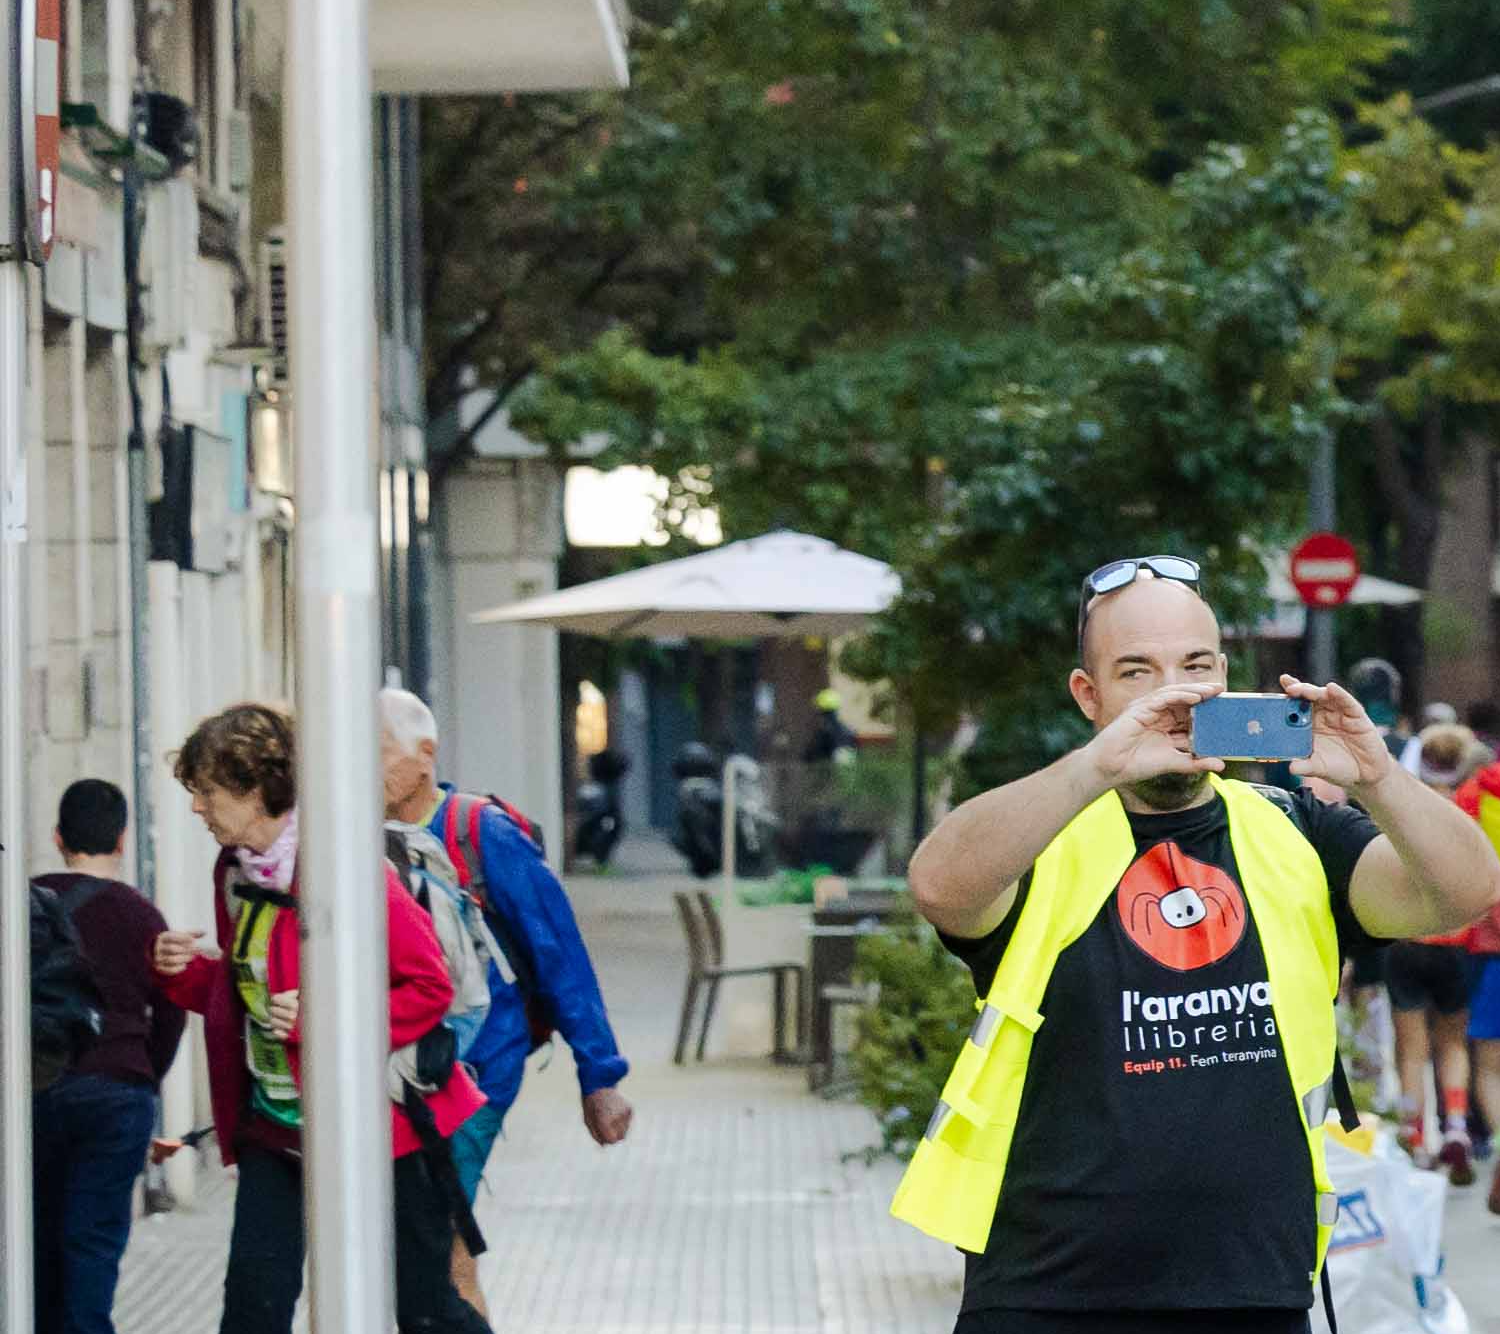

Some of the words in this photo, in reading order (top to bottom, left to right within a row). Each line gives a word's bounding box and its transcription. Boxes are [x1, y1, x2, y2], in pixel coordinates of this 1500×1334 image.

[1122, 981, 1273, 1022] l'aranya
[1124, 1013, 1276, 1052] llibreria
[1123, 1058, 1165, 1074] Equip
[1190, 1054, 1219, 1068] Fem
[1222, 1047, 1277, 1063] teranyina
